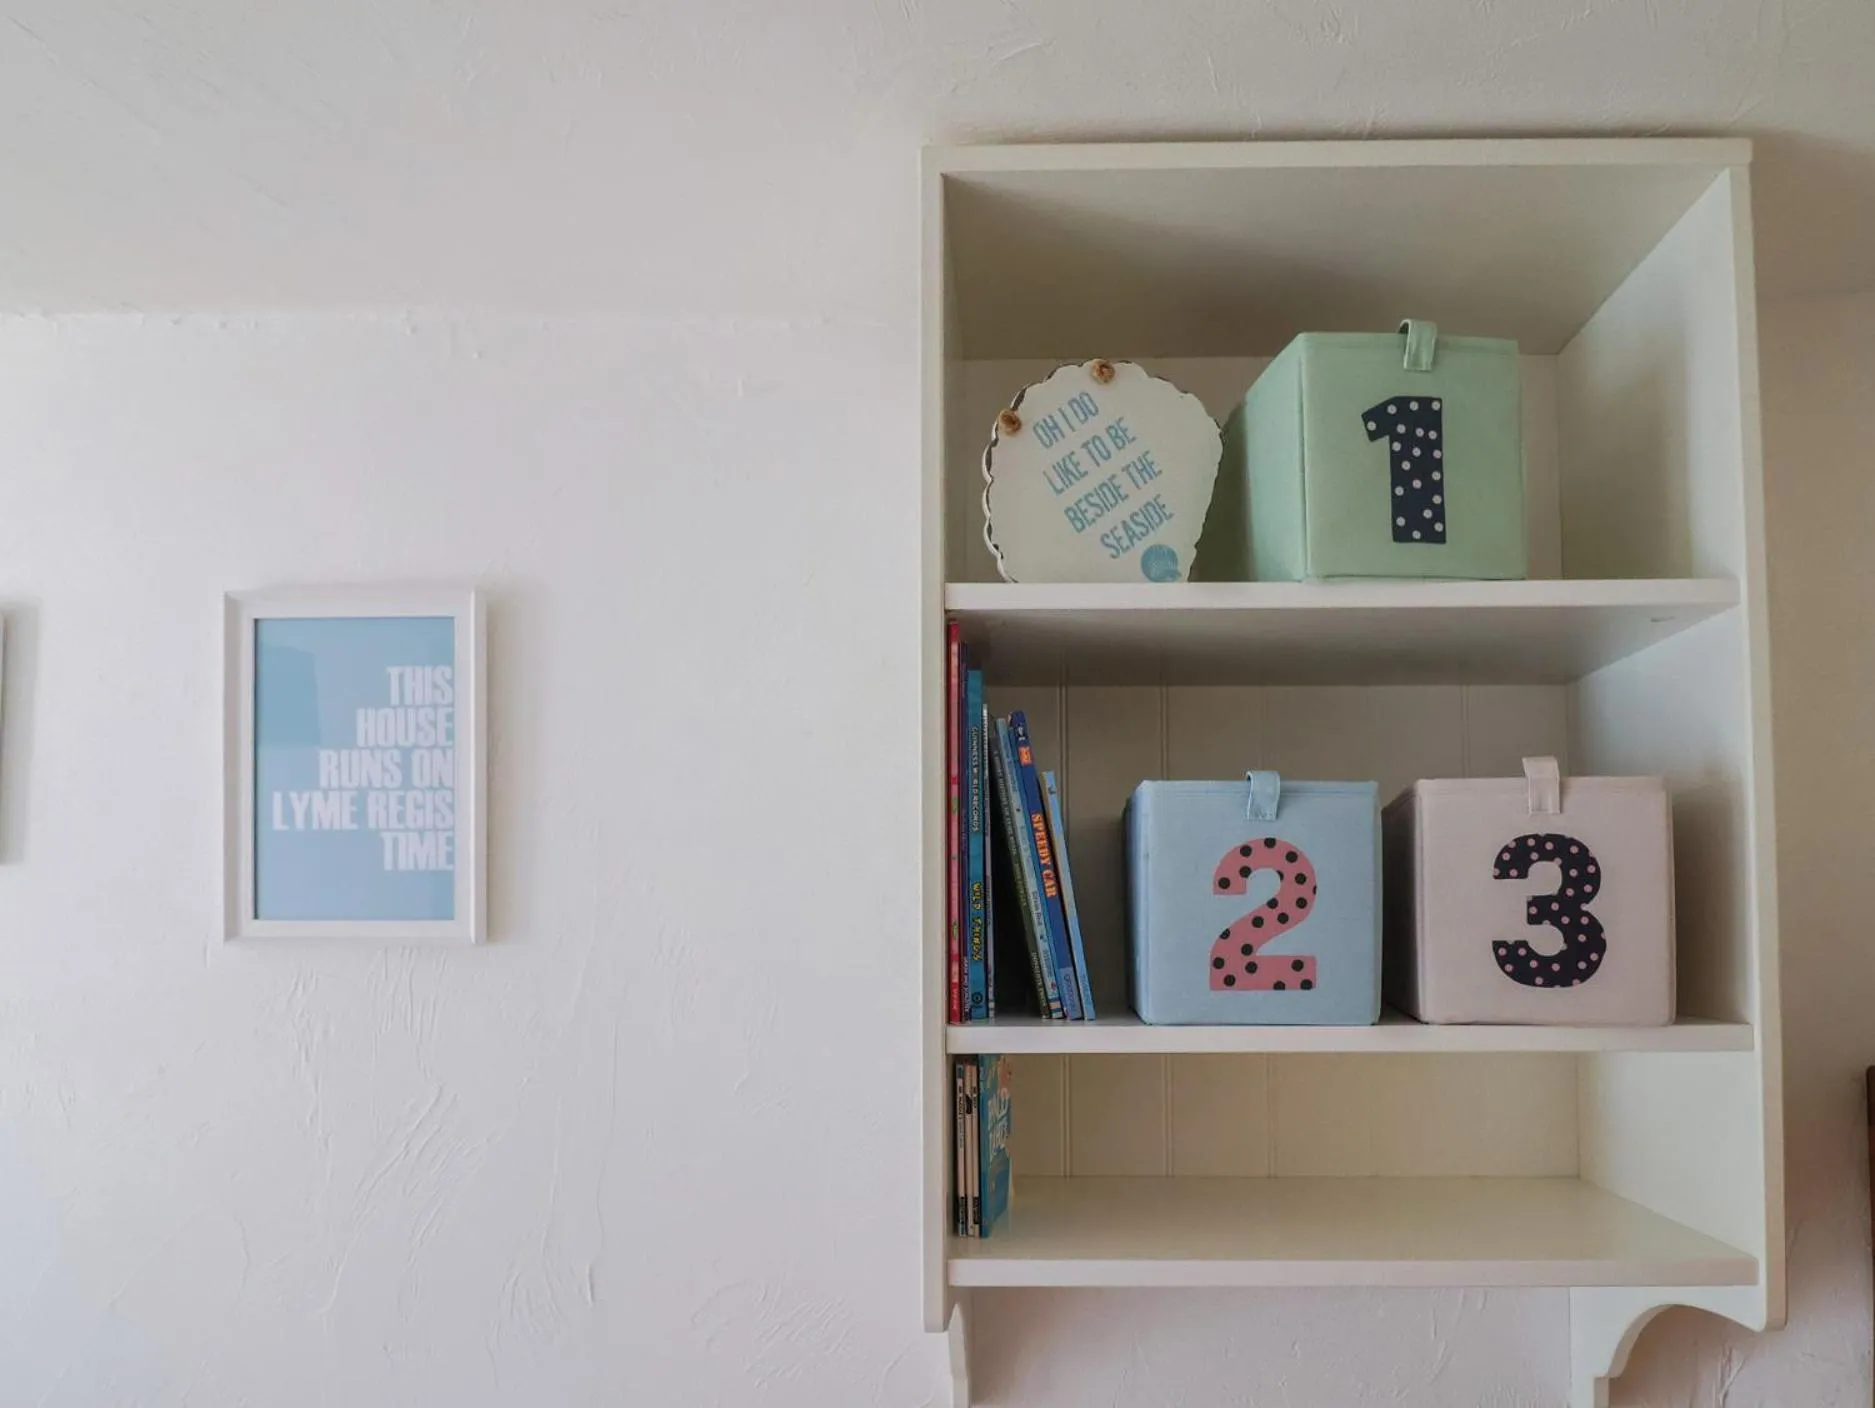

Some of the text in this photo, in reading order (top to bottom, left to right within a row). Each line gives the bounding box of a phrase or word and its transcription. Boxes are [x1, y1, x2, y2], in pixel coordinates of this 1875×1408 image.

[1032, 391, 1100, 449] OH I DO
[1042, 416, 1137, 495] LIKE TO BE
[1361, 396, 1446, 544] 1
[1063, 451, 1163, 533] BESIDE THE
[1100, 494, 1174, 559] SEASIDE
[386, 665, 454, 706] THIS
[356, 707, 454, 748] HOUSE
[971, 727, 980, 765] GUINNESS
[319, 749, 454, 789] RUNS ON
[272, 790, 454, 830] LYME REGIS
[972, 795, 980, 832] RECORDS
[380, 831, 454, 871] TIME
[1031, 813, 1058, 897] SPEEDY CAR
[972, 882, 984, 960] WILD THINGS
[1209, 837, 1317, 991] 2
[1492, 832, 1607, 988] 3
